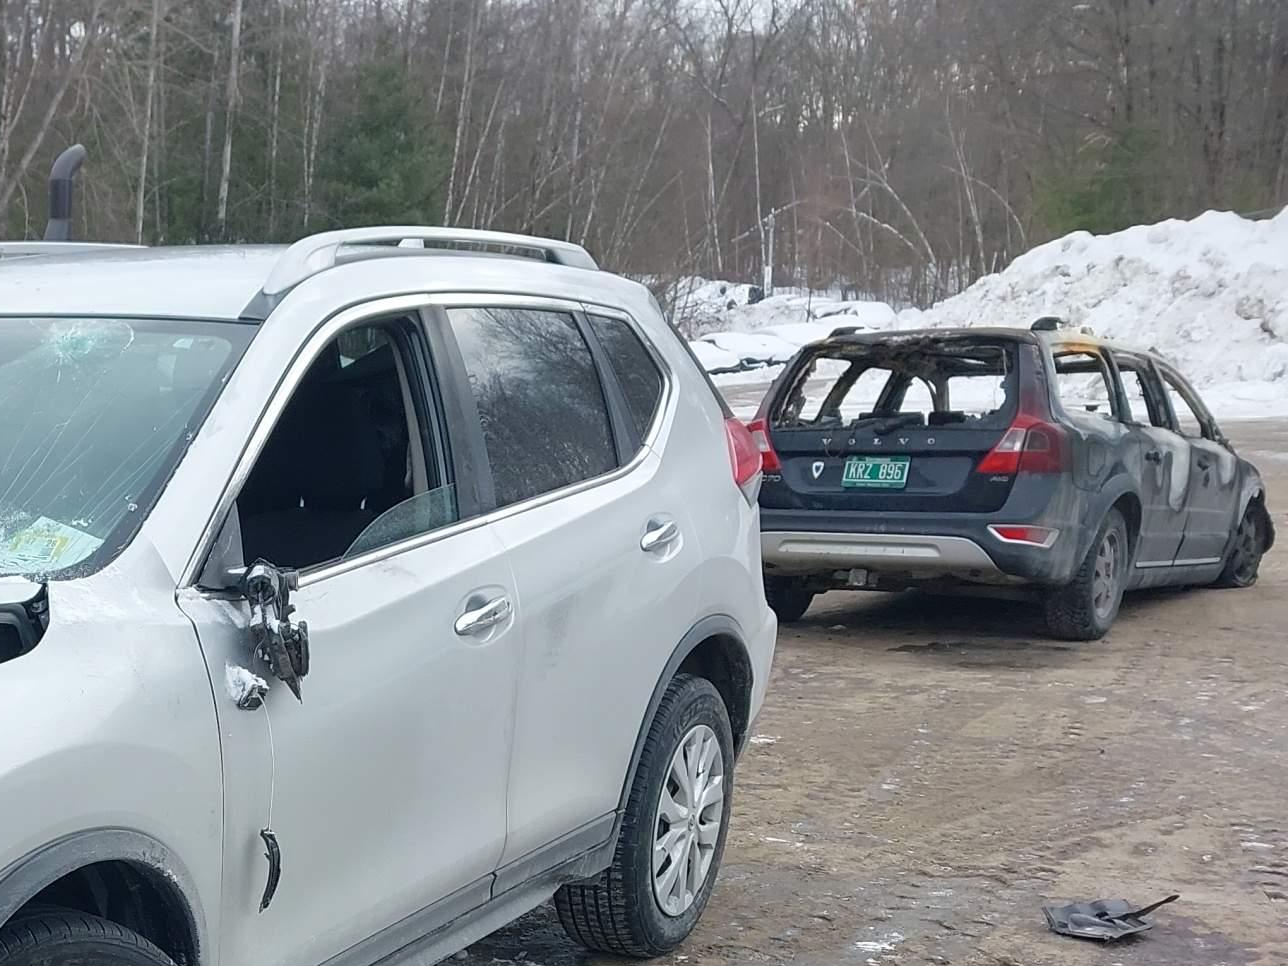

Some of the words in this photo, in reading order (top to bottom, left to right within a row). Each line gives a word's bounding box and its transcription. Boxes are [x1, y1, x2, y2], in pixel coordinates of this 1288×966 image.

[821, 437, 936, 446] VOLVO
[848, 463, 874, 479] KRZ
[878, 463, 904, 480] 896
